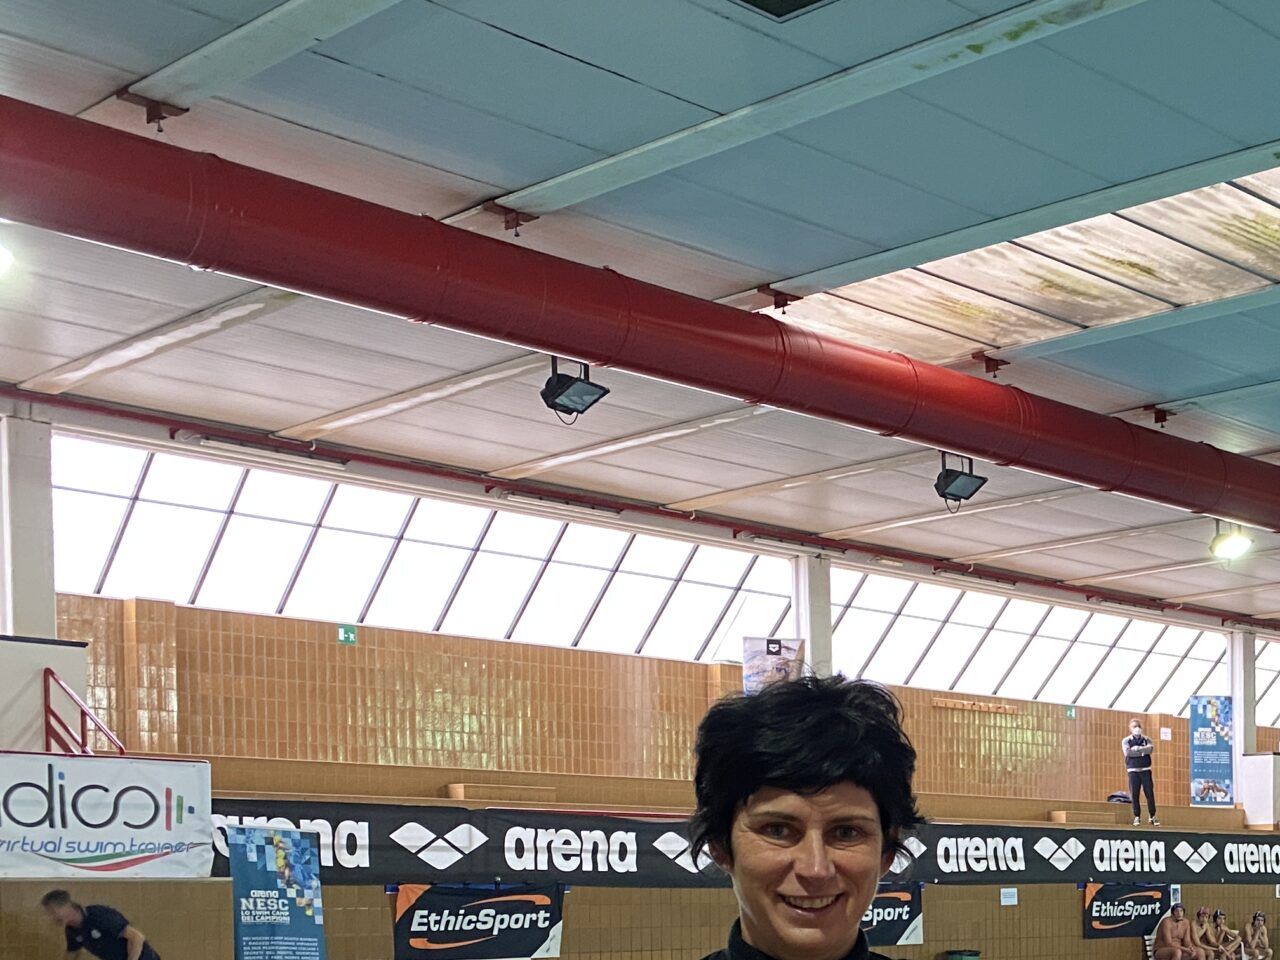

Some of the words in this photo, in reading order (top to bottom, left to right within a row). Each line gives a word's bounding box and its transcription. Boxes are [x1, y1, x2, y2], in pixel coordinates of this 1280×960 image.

[65, 840, 126, 853] swim
[130, 837, 195, 853] trainer
[504, 826, 638, 873] arena
[937, 836, 1026, 873] arena
[1093, 838, 1166, 872] arena
[240, 898, 289, 910] NESC
[250, 890, 279, 898] arena
[410, 908, 550, 936] EthicSport
[1091, 900, 1161, 920] EthicSport
